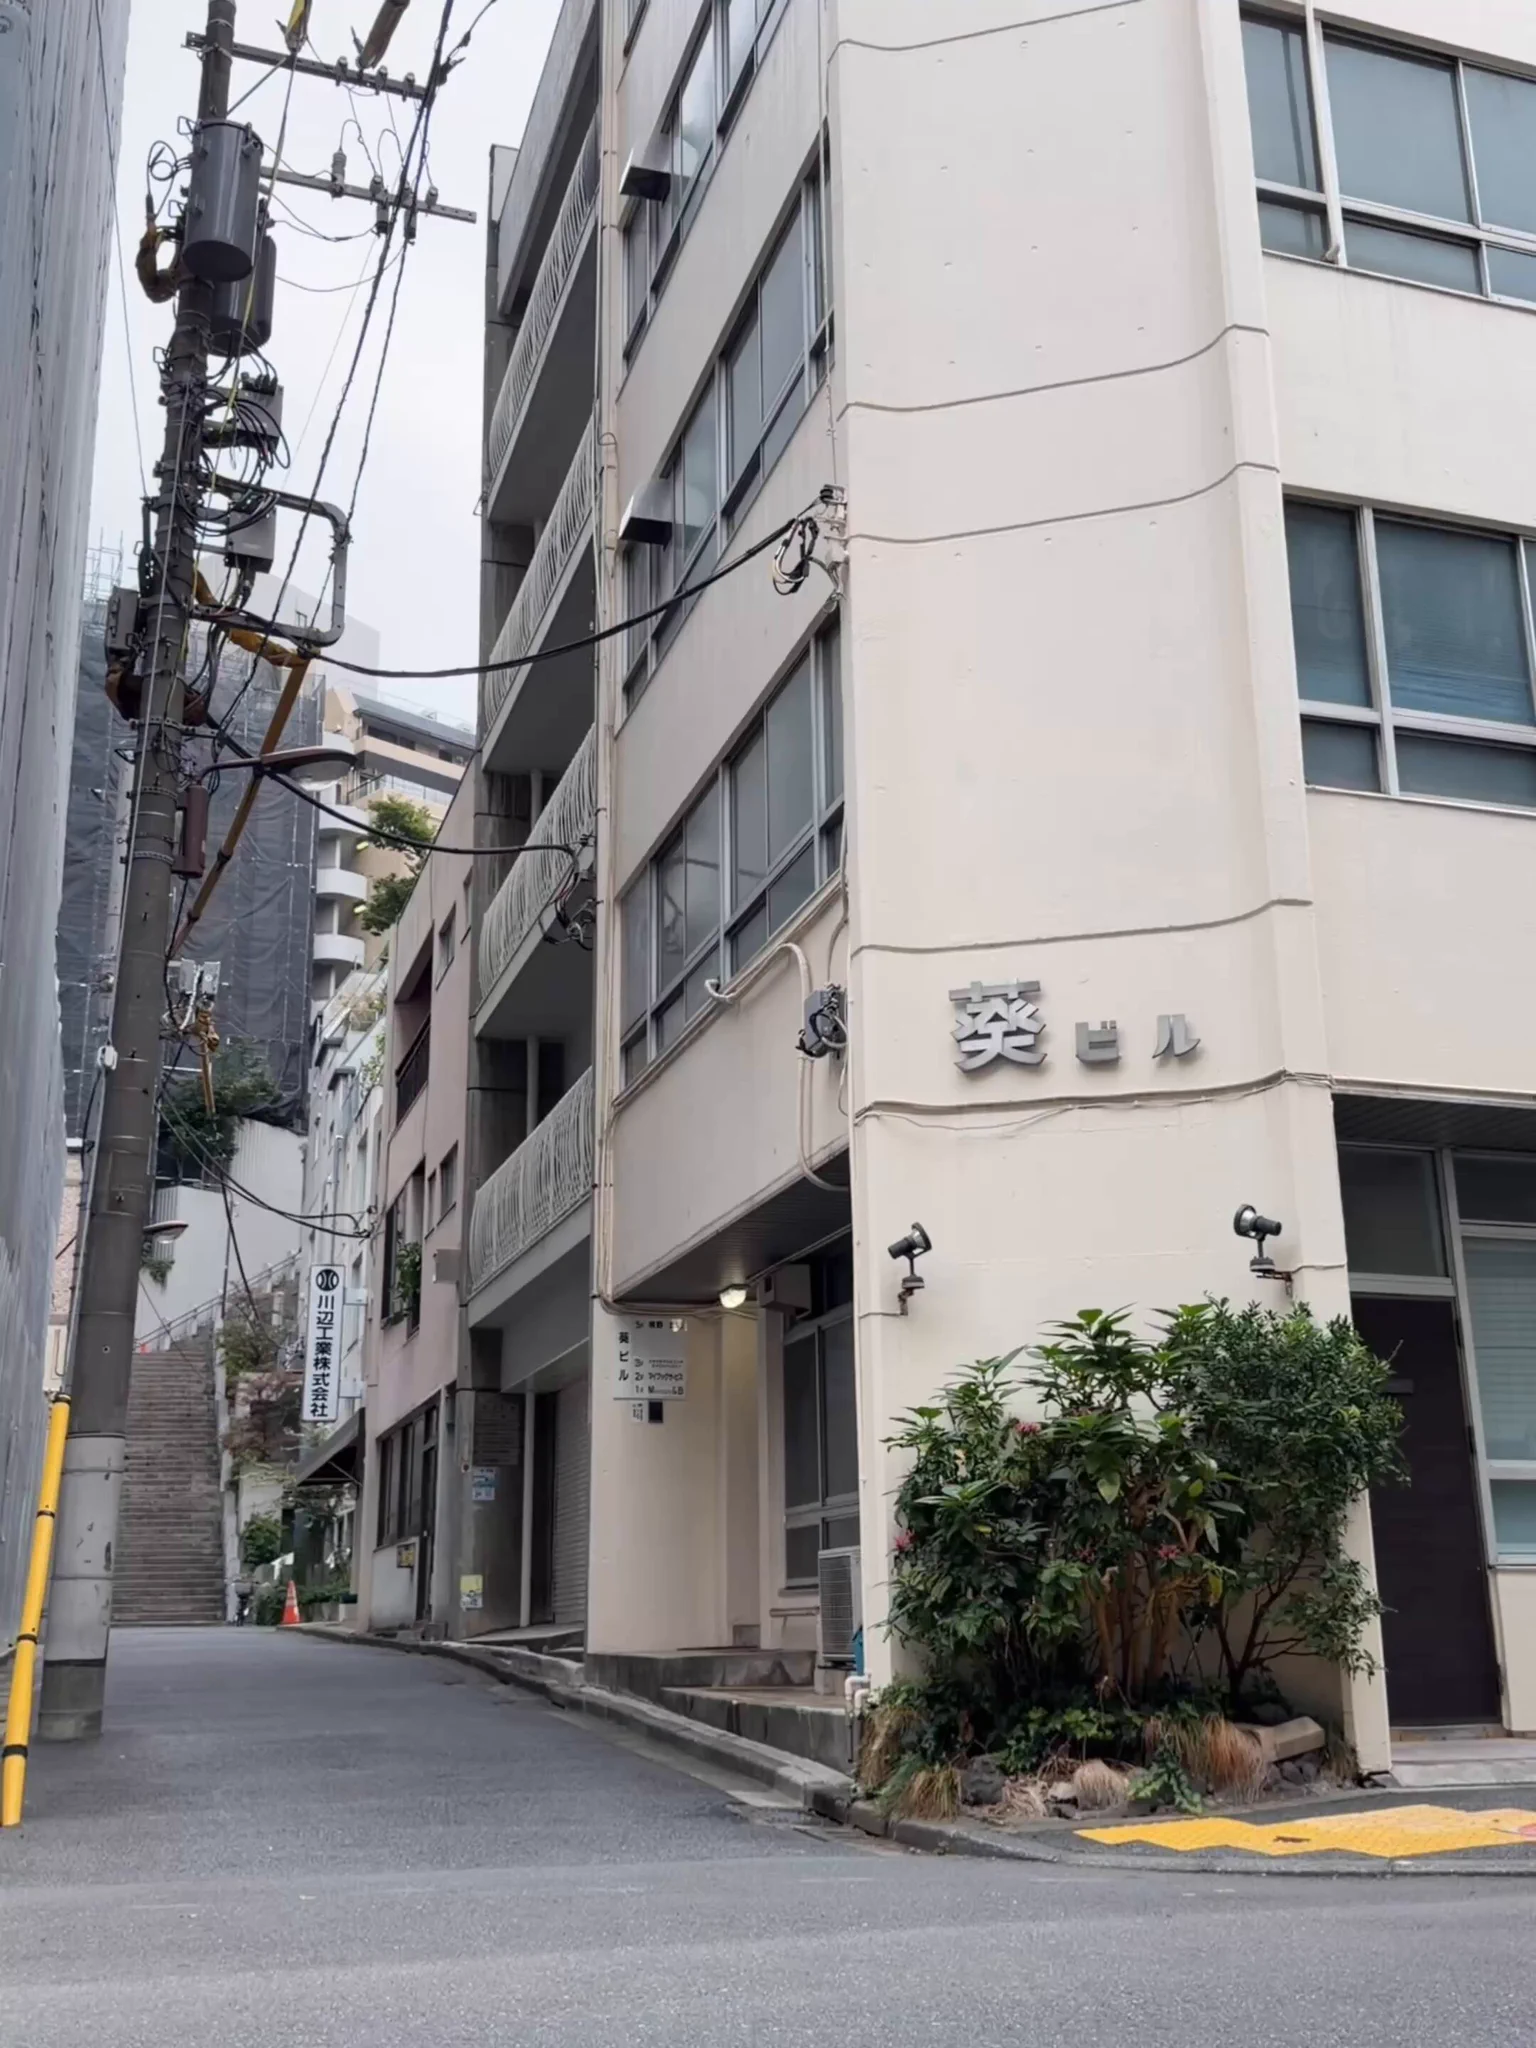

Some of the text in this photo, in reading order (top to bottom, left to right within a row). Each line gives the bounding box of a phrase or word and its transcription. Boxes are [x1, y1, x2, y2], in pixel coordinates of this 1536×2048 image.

[949, 979, 1201, 1073] 葵ビル
[310, 1295, 335, 1418] 川辺工業株式会社
